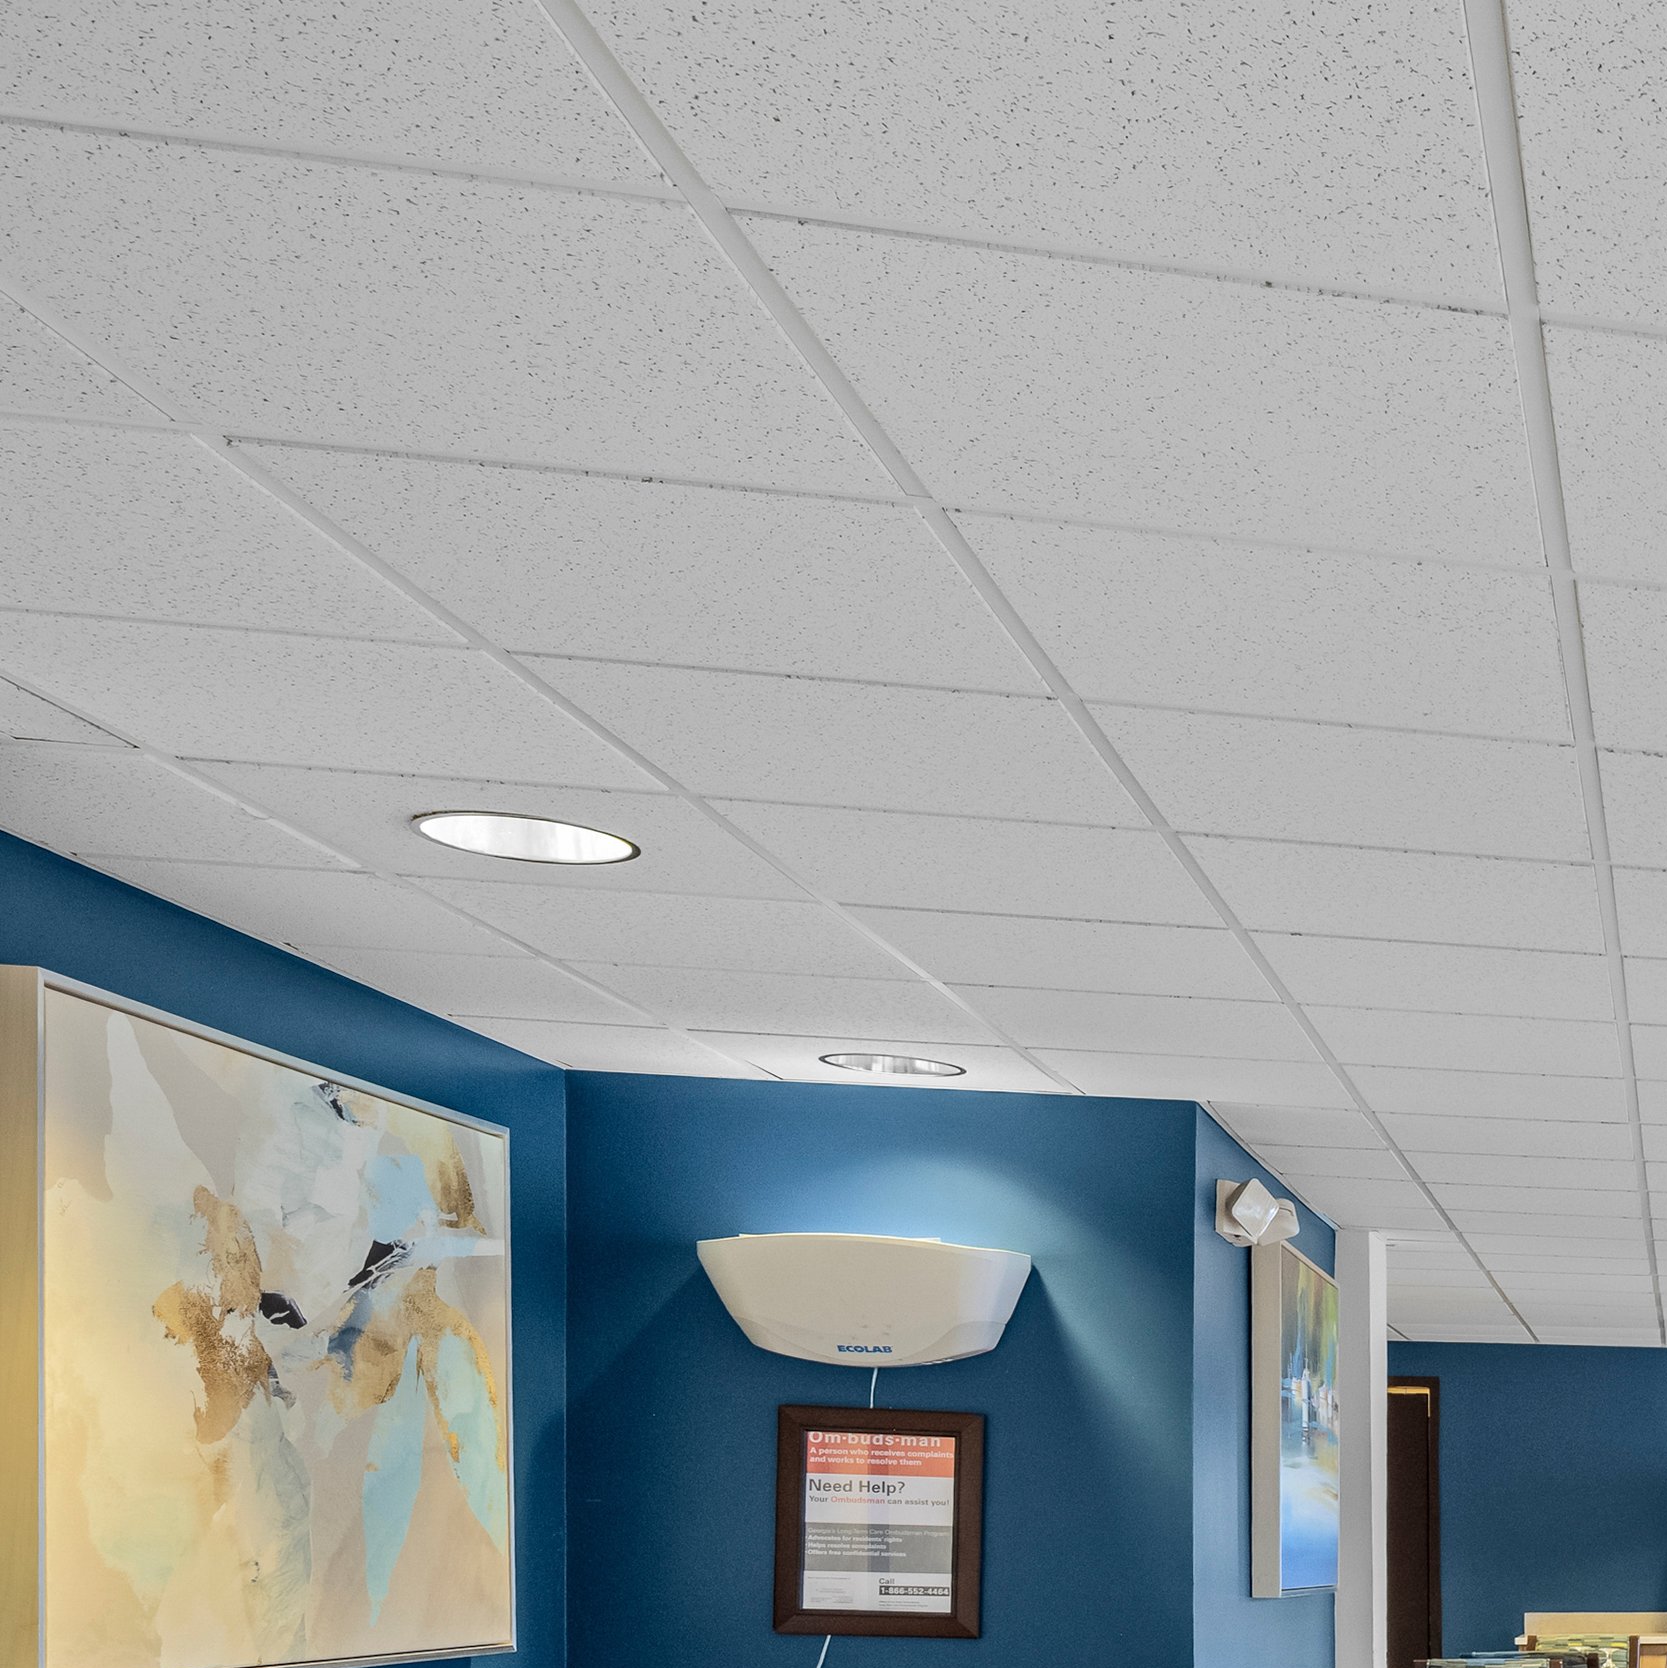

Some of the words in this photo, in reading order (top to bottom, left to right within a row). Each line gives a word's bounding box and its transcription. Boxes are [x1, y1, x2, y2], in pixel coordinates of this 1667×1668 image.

[836, 1344, 893, 1353] ECOLAB
[809, 1479, 853, 1492] Need
[859, 1480, 905, 1496] Help?
[809, 1495, 828, 1503] Your
[830, 1496, 885, 1505] Ombudsman
[931, 1499, 950, 1507] you!
[880, 1586, 949, 1595] 1-866-552-4464
